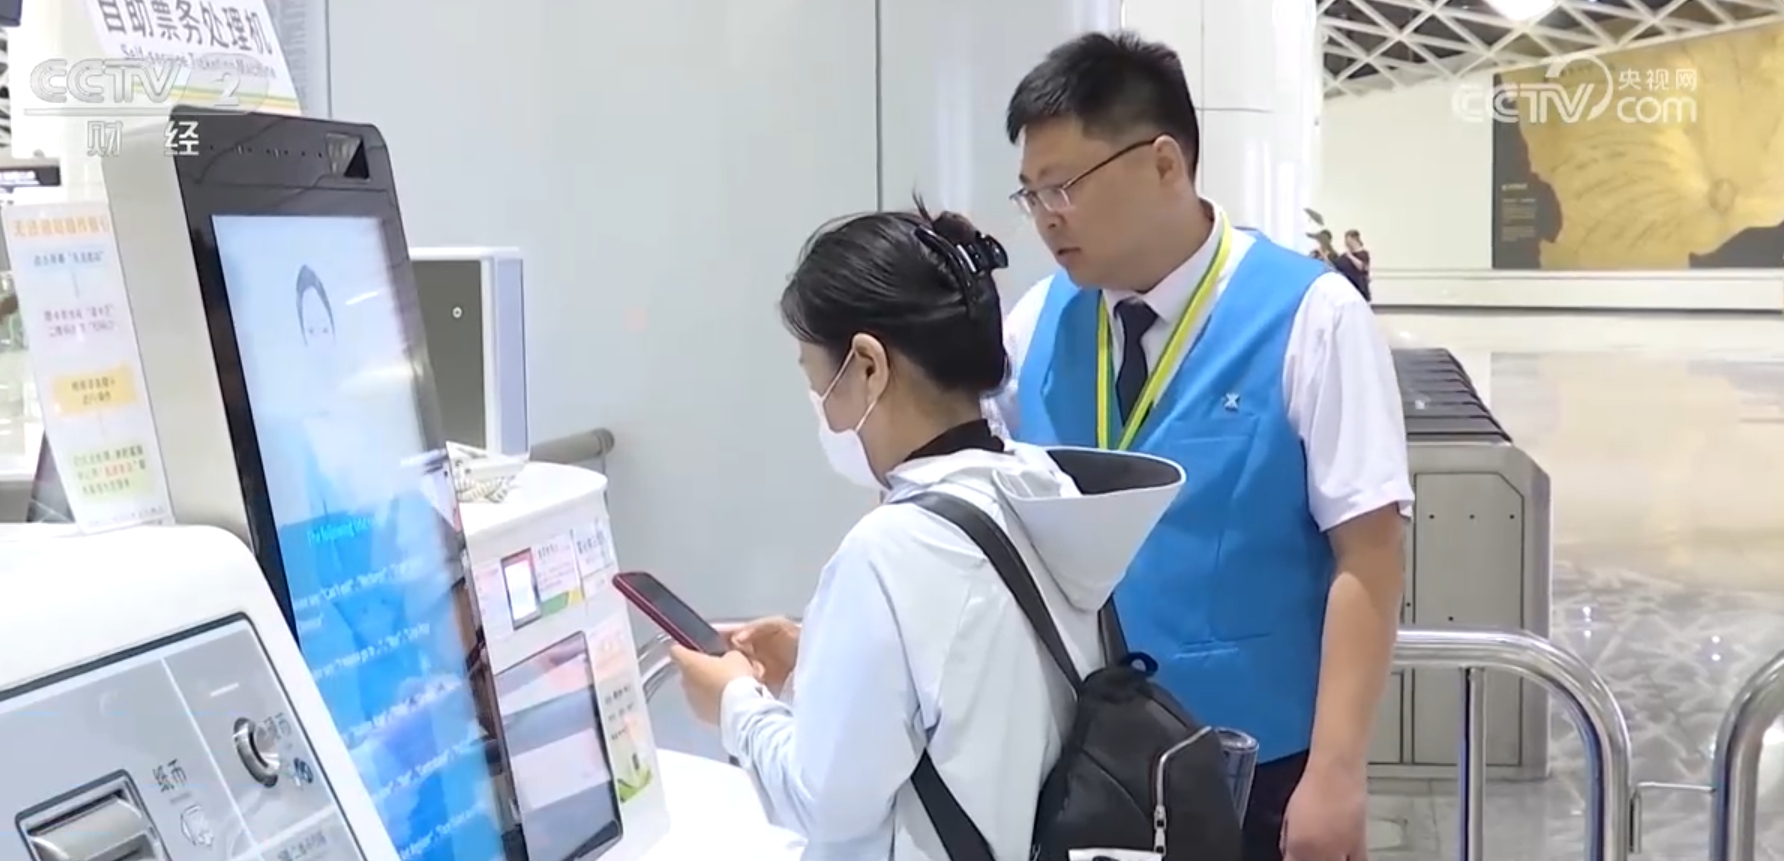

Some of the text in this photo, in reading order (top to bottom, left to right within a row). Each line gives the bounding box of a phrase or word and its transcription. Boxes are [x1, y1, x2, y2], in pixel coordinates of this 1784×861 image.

[97, 0, 274, 56] 自助票务处理机
[152, 758, 187, 793] 纸币
